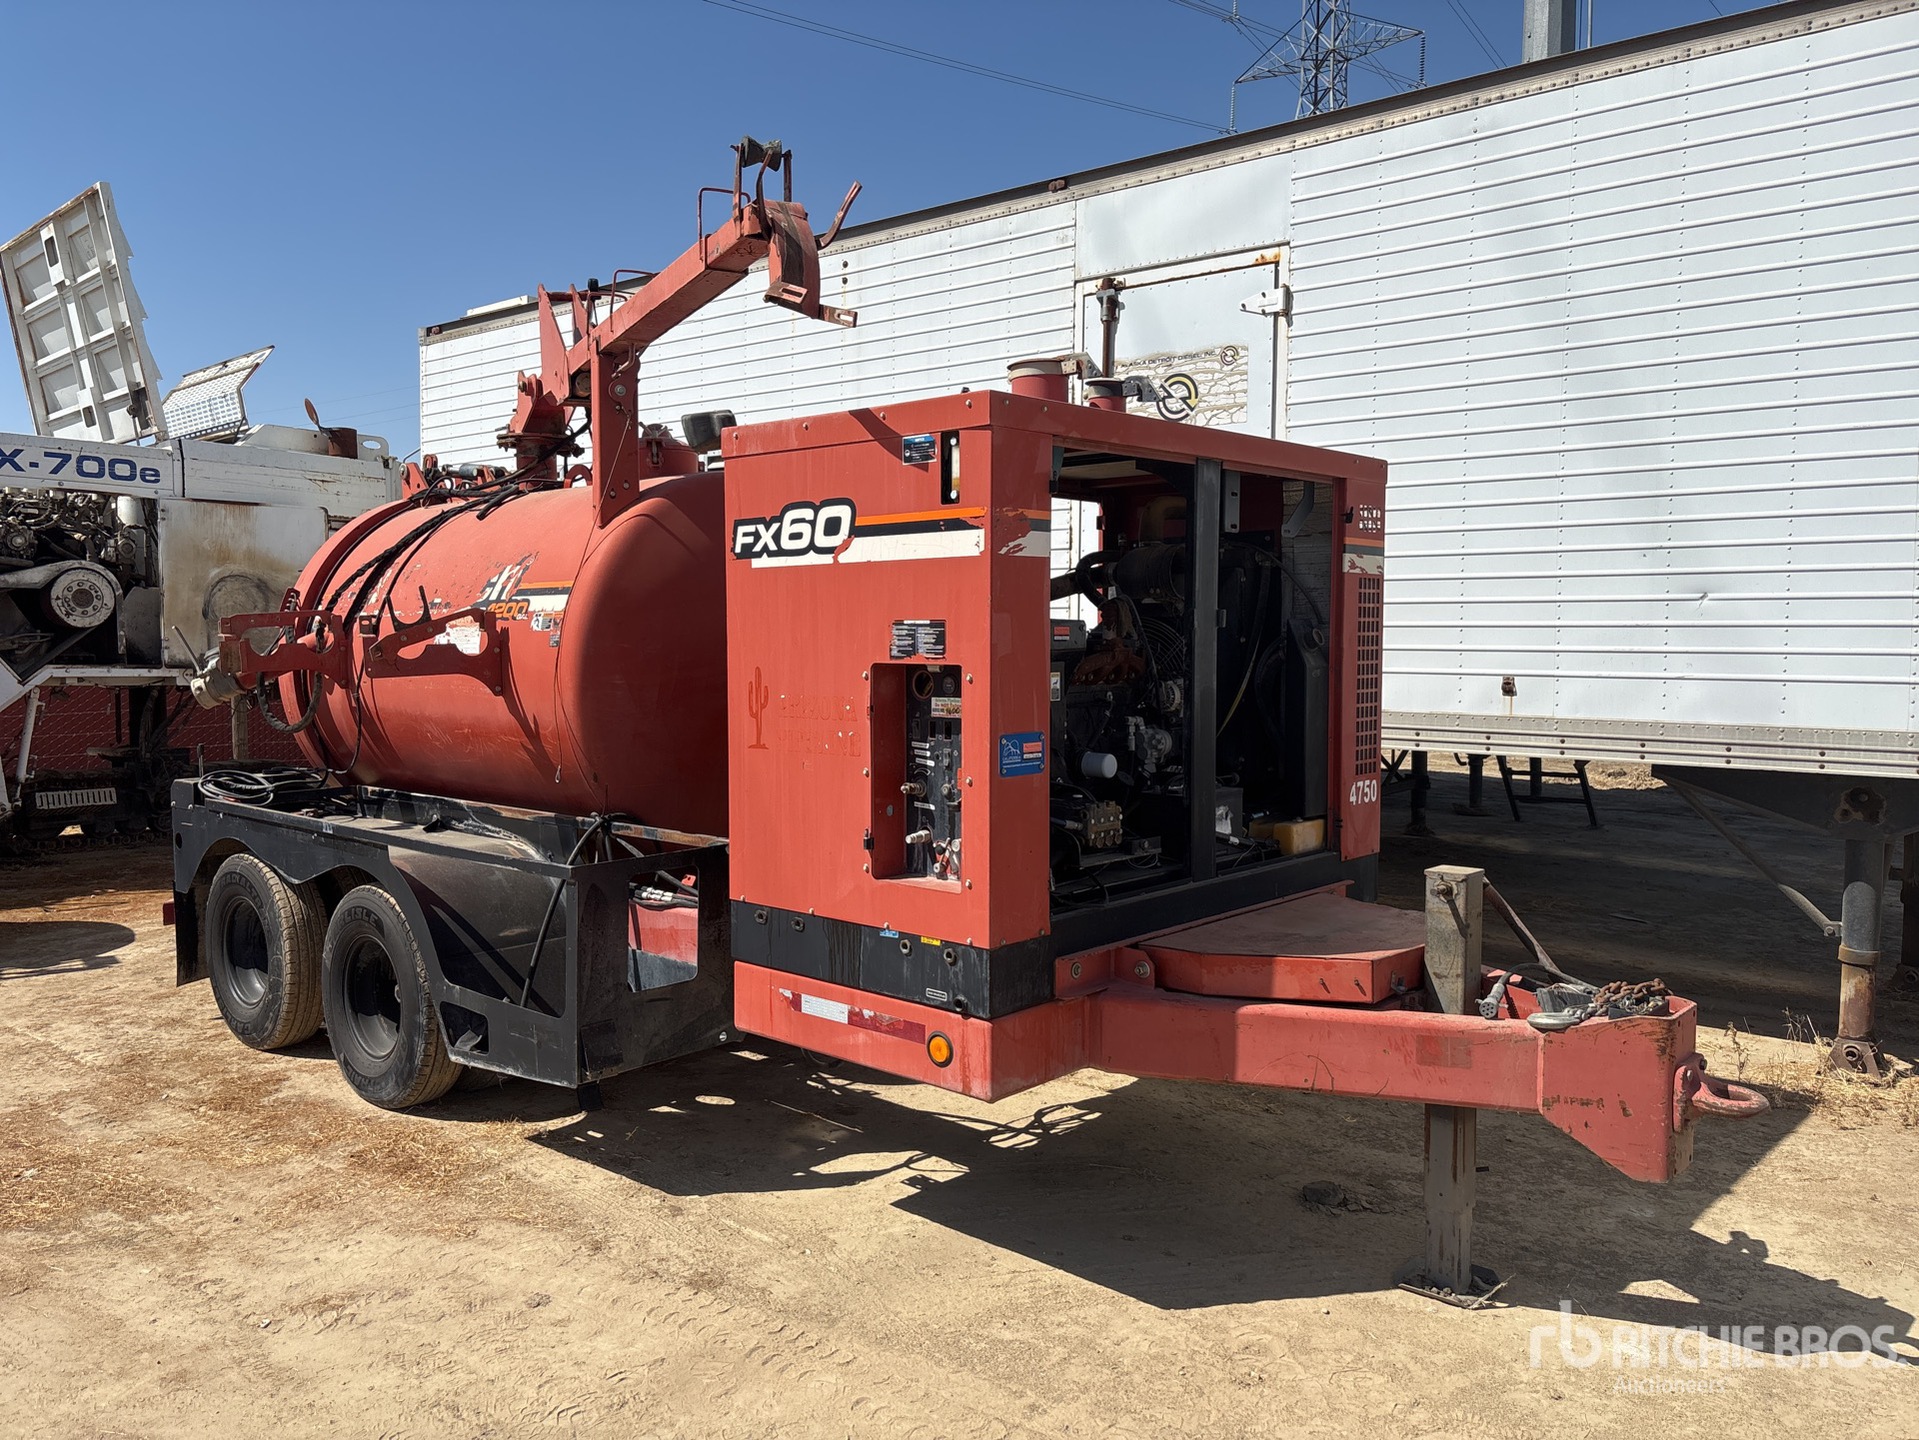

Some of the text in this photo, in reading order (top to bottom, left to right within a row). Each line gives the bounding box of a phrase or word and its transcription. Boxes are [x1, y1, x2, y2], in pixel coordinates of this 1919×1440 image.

[1147, 355, 1178, 366] DETROIT
[733, 502, 854, 555] FX60
[1348, 779, 1378, 806] 4750
